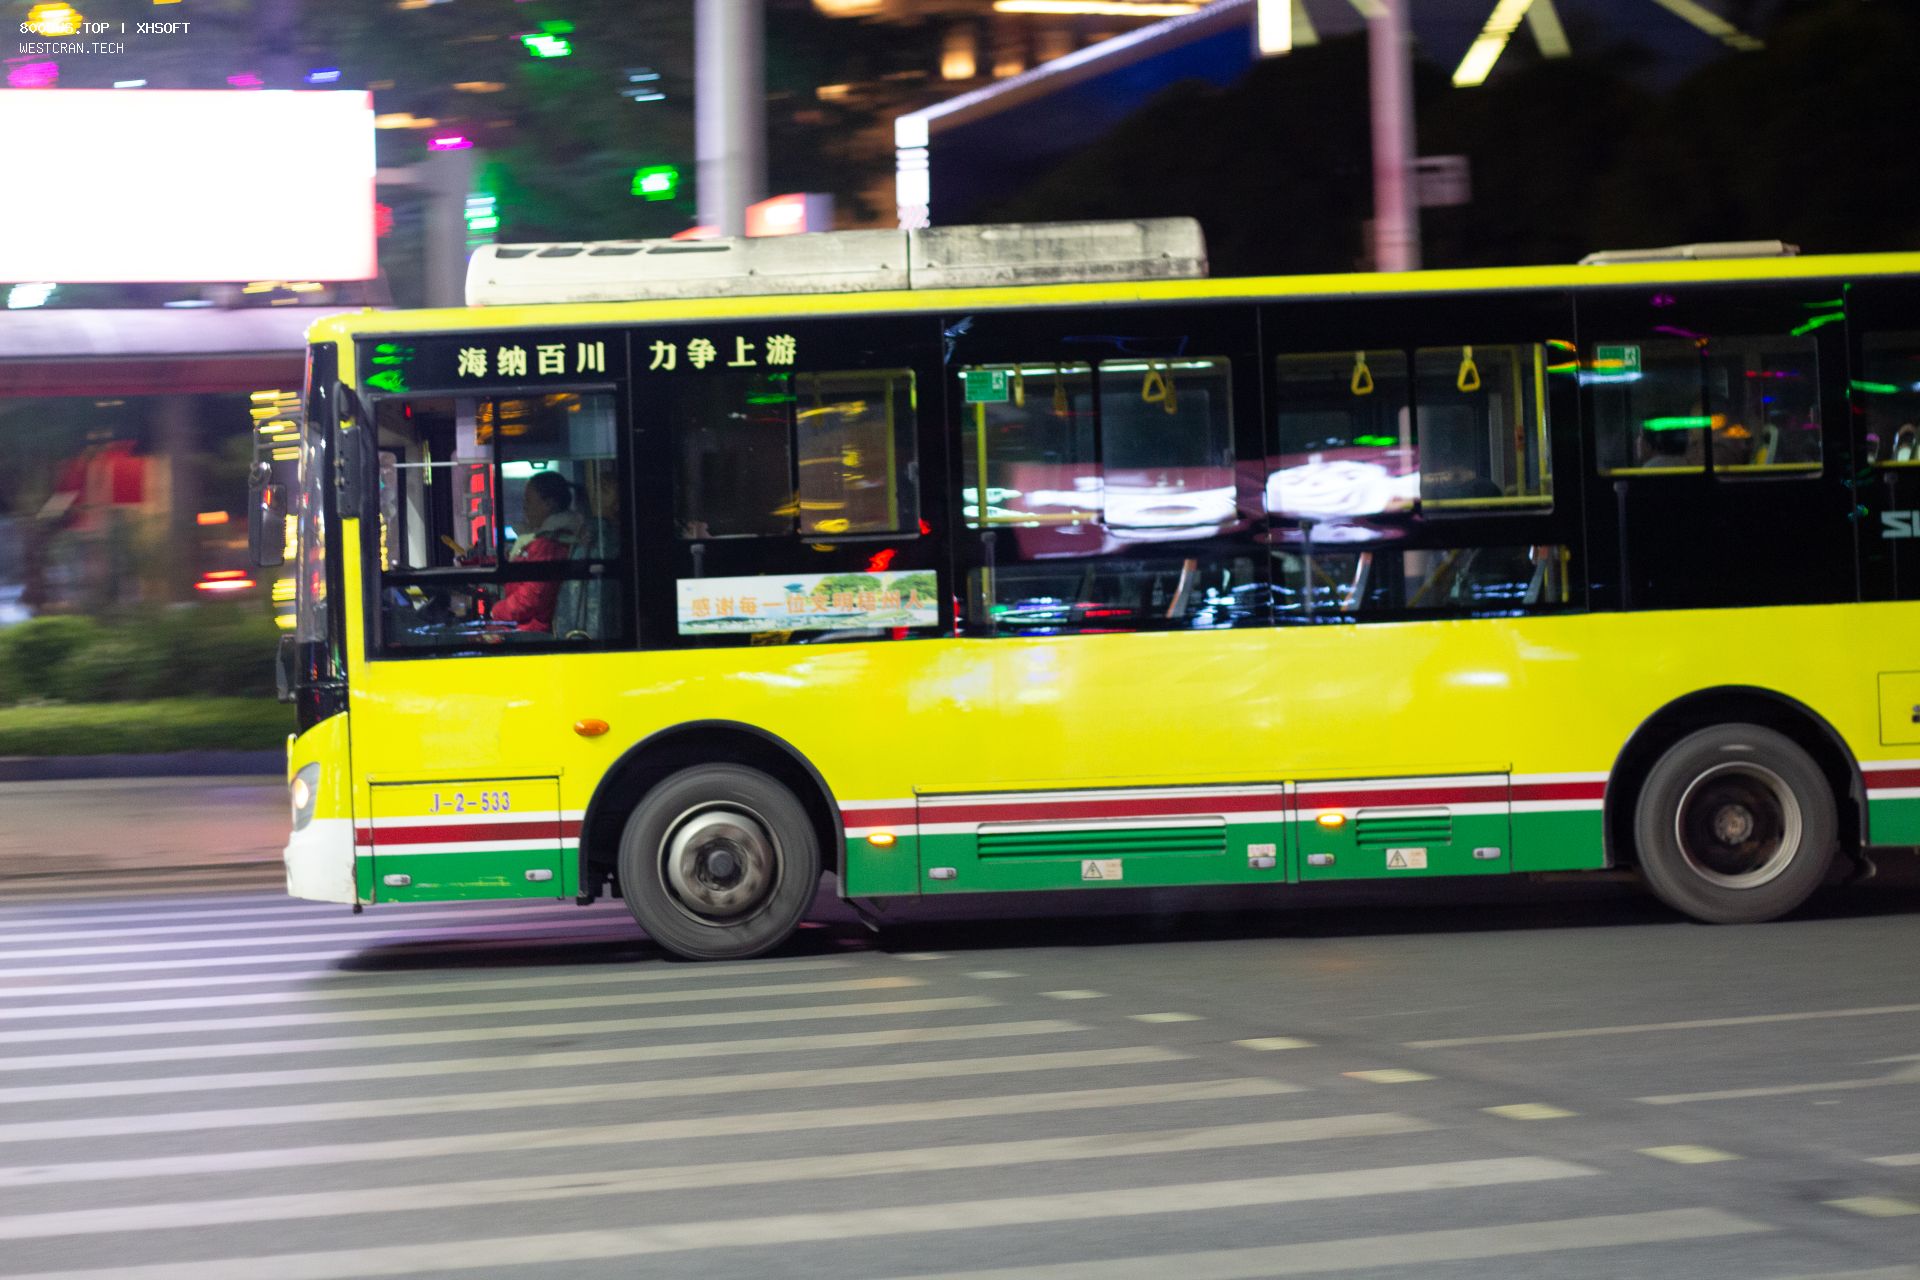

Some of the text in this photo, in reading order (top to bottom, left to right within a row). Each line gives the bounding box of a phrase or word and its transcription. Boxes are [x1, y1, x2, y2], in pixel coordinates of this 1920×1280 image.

[458, 334, 797, 377] 海纳百川 力争上游
[430, 791, 510, 812] J-2-533
